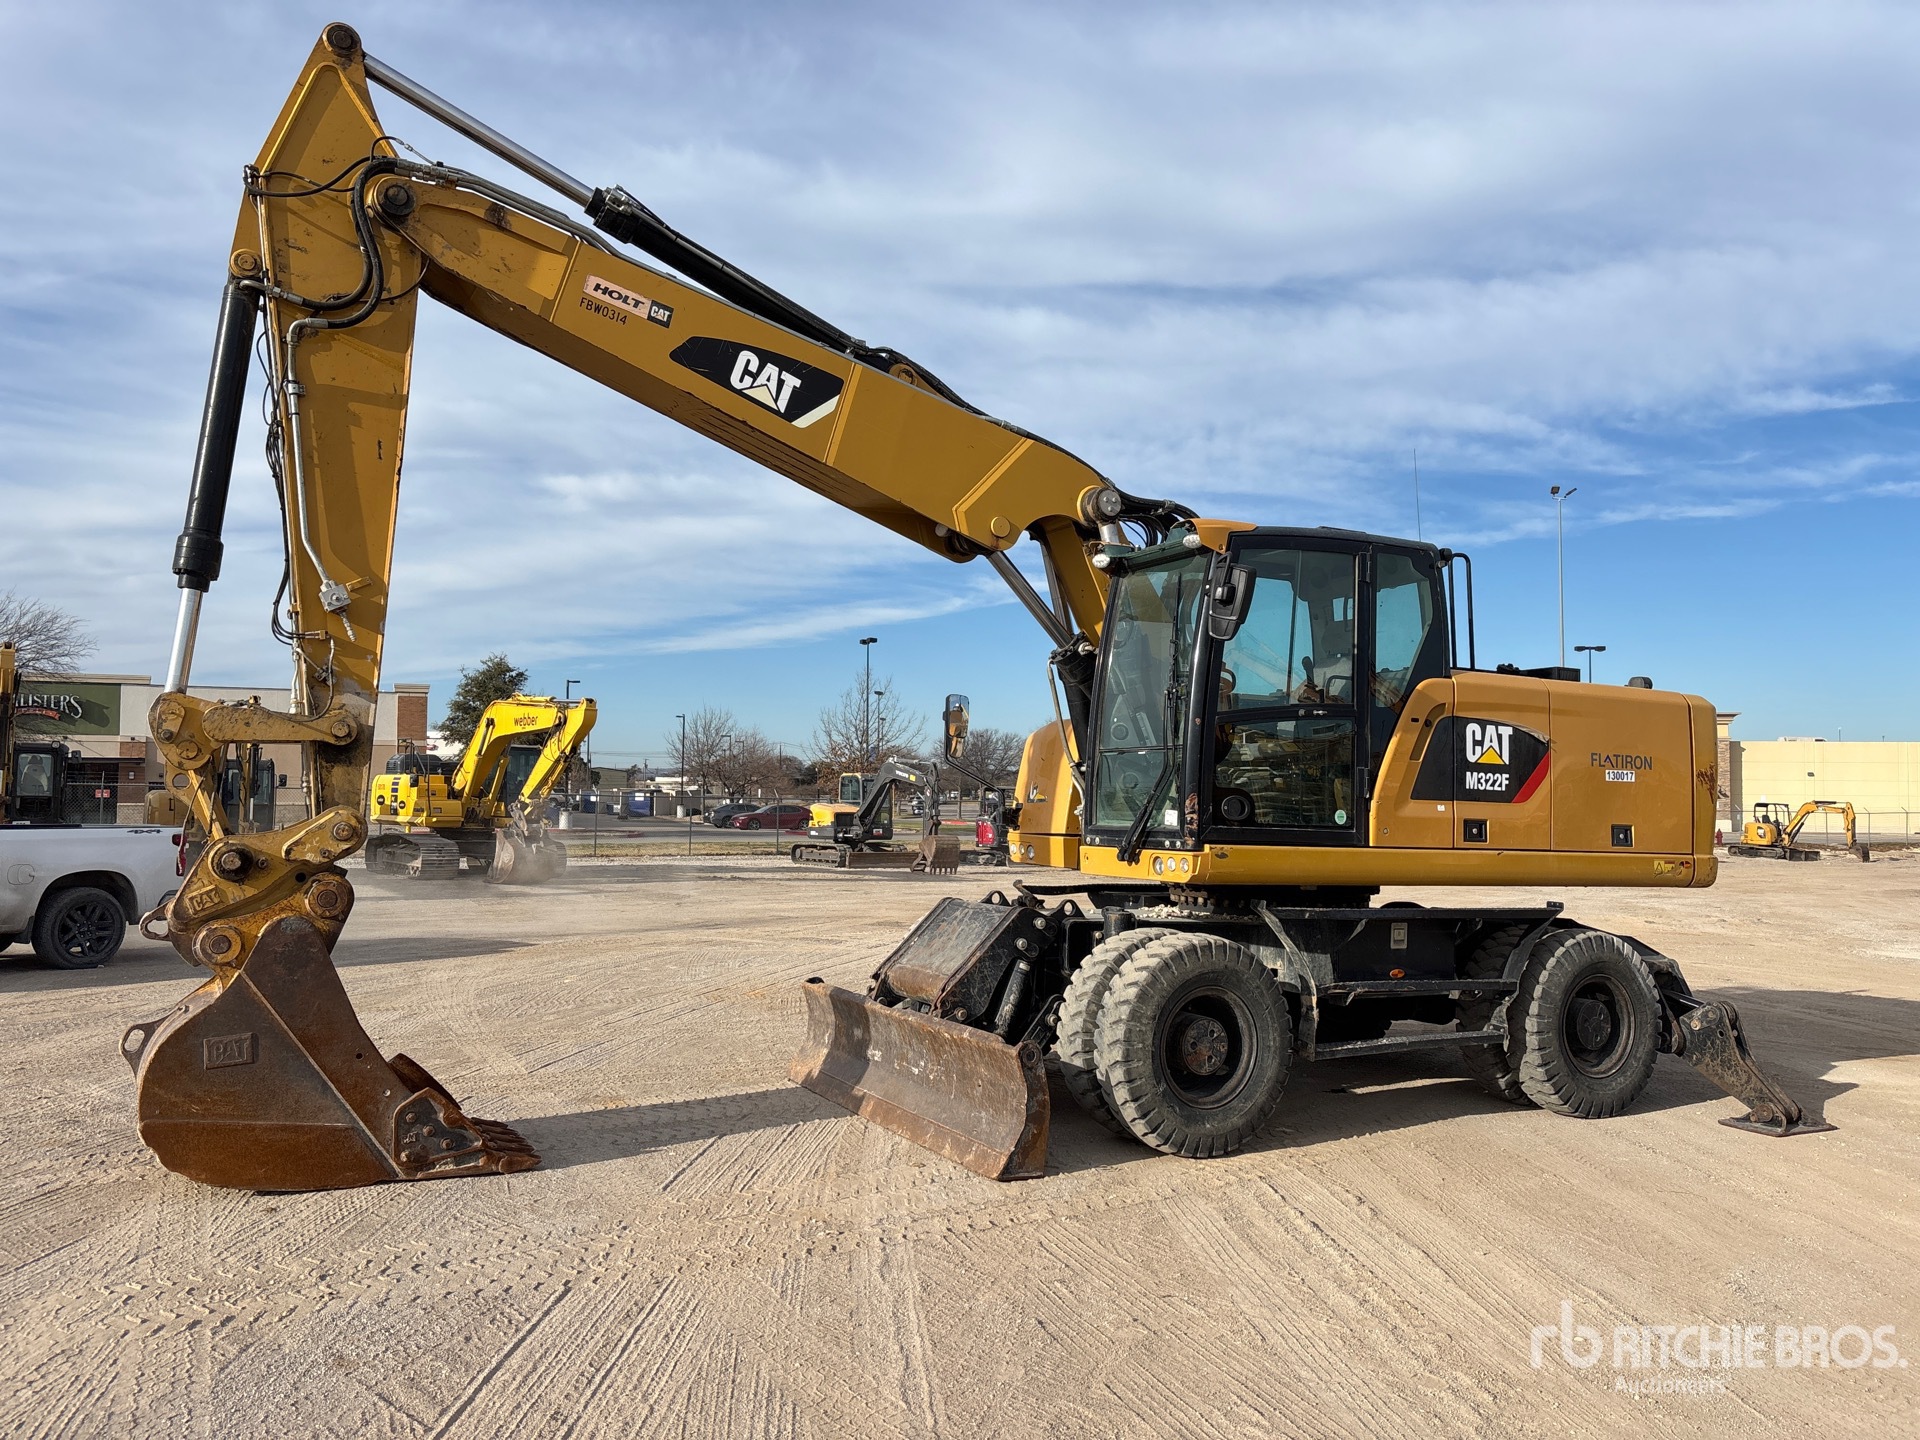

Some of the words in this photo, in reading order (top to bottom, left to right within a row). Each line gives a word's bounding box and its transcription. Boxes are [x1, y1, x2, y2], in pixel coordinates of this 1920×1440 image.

[580, 297, 627, 325] FBW0314
[593, 283, 645, 309] HOLT
[650, 306, 671, 322] CAT
[730, 350, 802, 413] CAT
[514, 713, 538, 726] webber
[1466, 722, 1513, 765] CAT
[1591, 753, 1652, 770] FLATIRON
[1465, 772, 1509, 791] M322F
[1606, 771, 1634, 781] 130017
[193, 890, 221, 911] CAT
